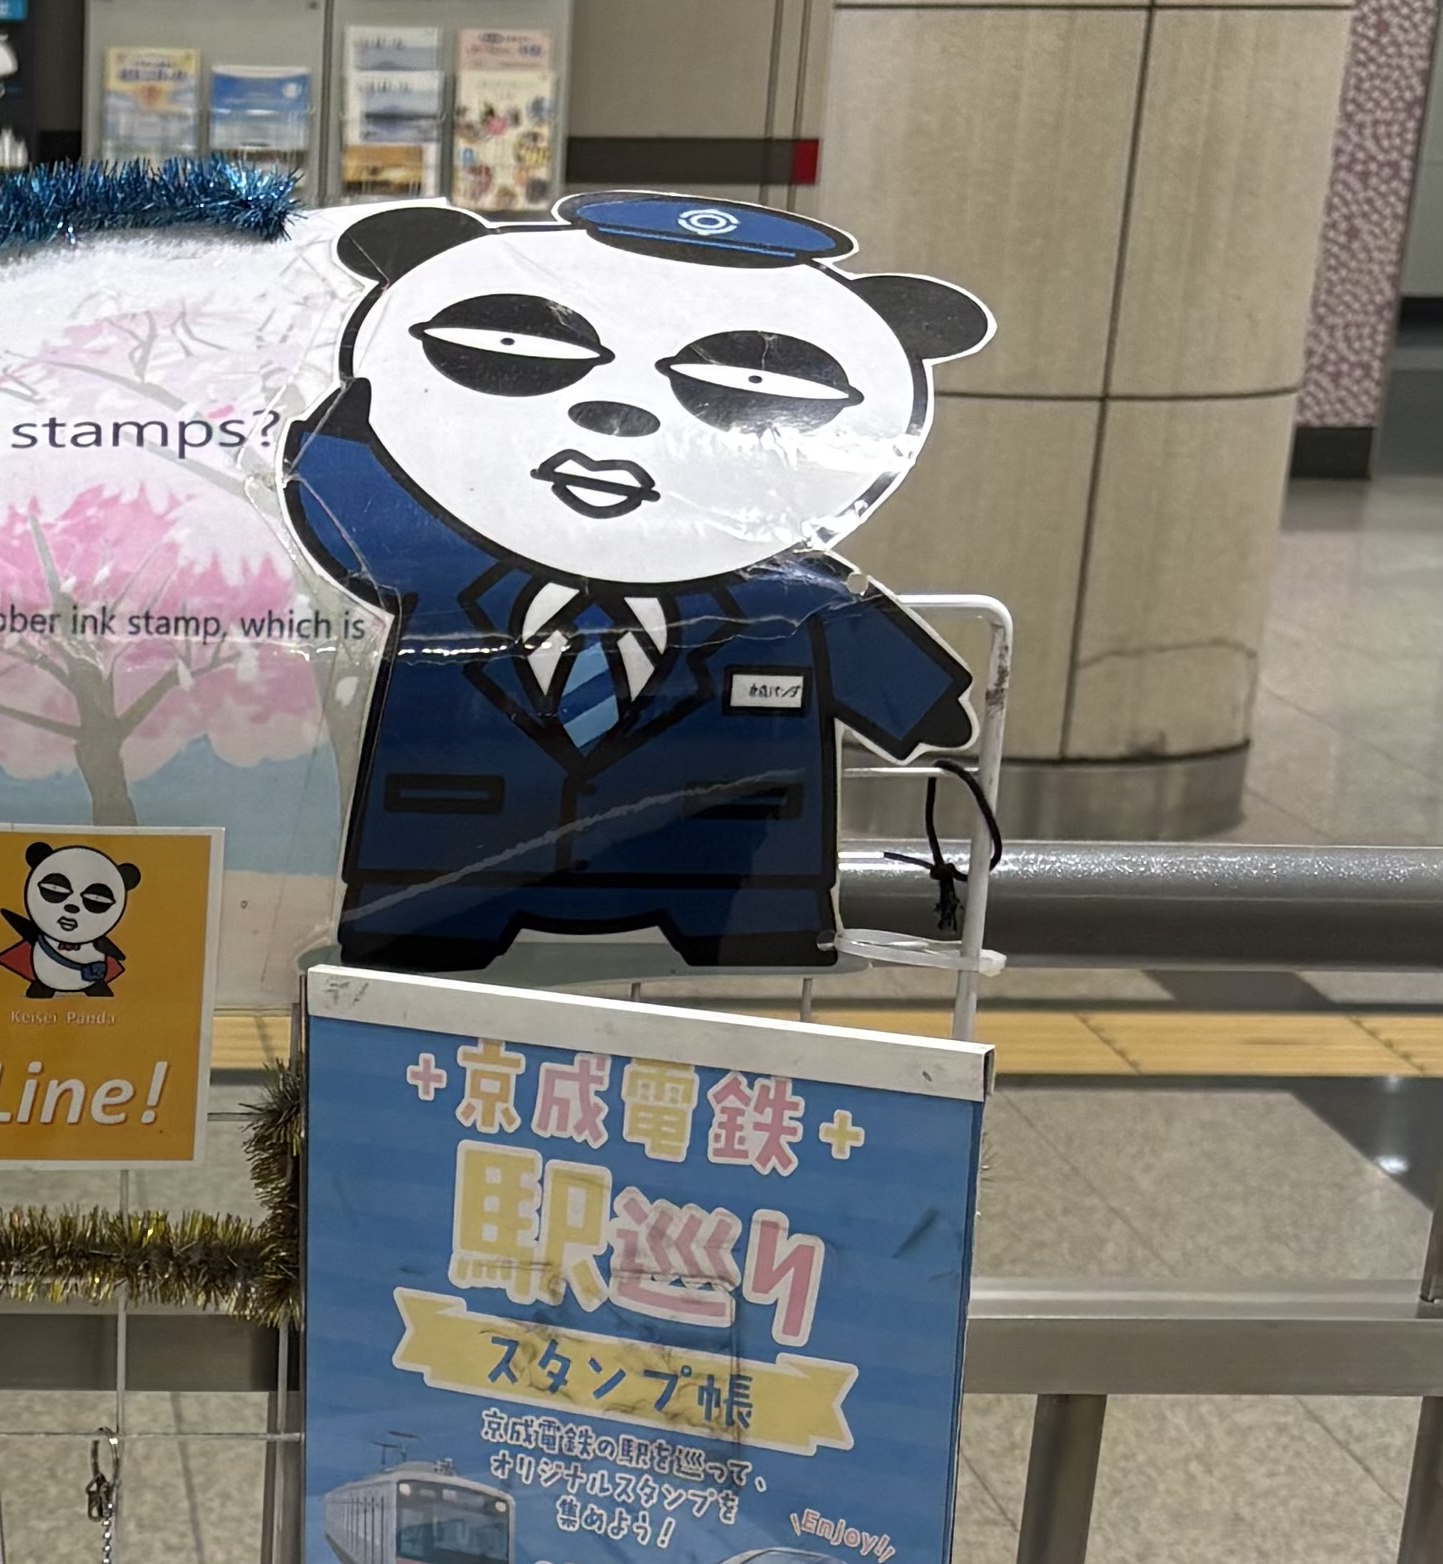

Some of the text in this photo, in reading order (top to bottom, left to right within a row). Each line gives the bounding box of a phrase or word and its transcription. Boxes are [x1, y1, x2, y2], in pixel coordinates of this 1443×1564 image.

[11, 409, 281, 458] stamps?
[72, 605, 115, 635] ink
[129, 610, 228, 643] stamp,
[240, 606, 331, 639] which
[343, 612, 365, 639] is
[457, 1038, 805, 1176] 京成電鉄
[449, 1140, 825, 1346] 駅巡り
[488, 1336, 752, 1430] スタンプ帳
[481, 1408, 767, 1493] 京成電鉄の駅を巡って、
[491, 1450, 738, 1525] オリジナルスタンプを
